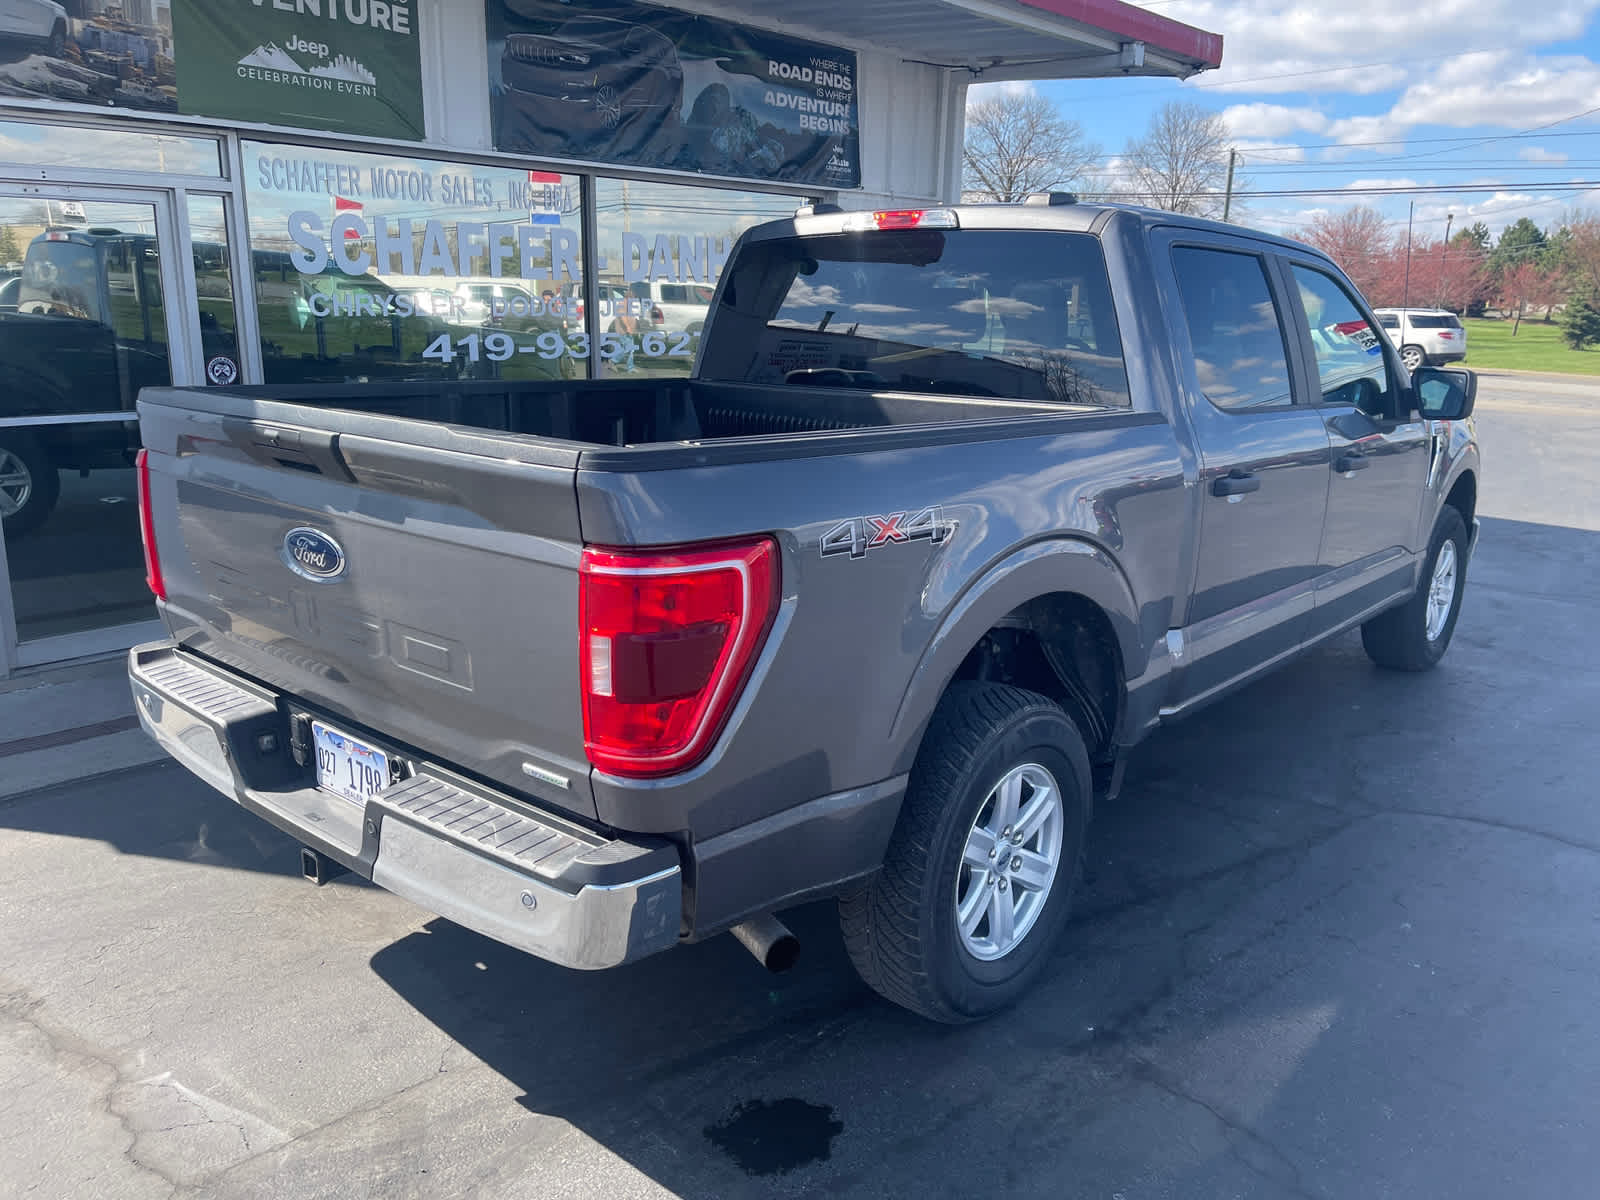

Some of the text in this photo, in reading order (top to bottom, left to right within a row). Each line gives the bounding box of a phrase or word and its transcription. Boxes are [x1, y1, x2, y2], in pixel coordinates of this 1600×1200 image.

[285, 34, 329, 58] Jeep
[768, 60, 852, 91] ROAD ENDS
[810, 57, 851, 74] WHERE THE
[237, 66, 377, 97] CELEBRATION EVENT
[816, 87, 825, 97] IS
[764, 91, 851, 118] ADVENTURE
[799, 114, 850, 136] BEGINS
[258, 155, 361, 196] SCHAFFER
[370, 167, 433, 202] MOTOR
[287, 211, 581, 281] SCHAFFER
[309, 293, 653, 319] CHRYSLER DODGE JEEP
[294, 536, 327, 568] Ford
[319, 747, 336, 776] 027
